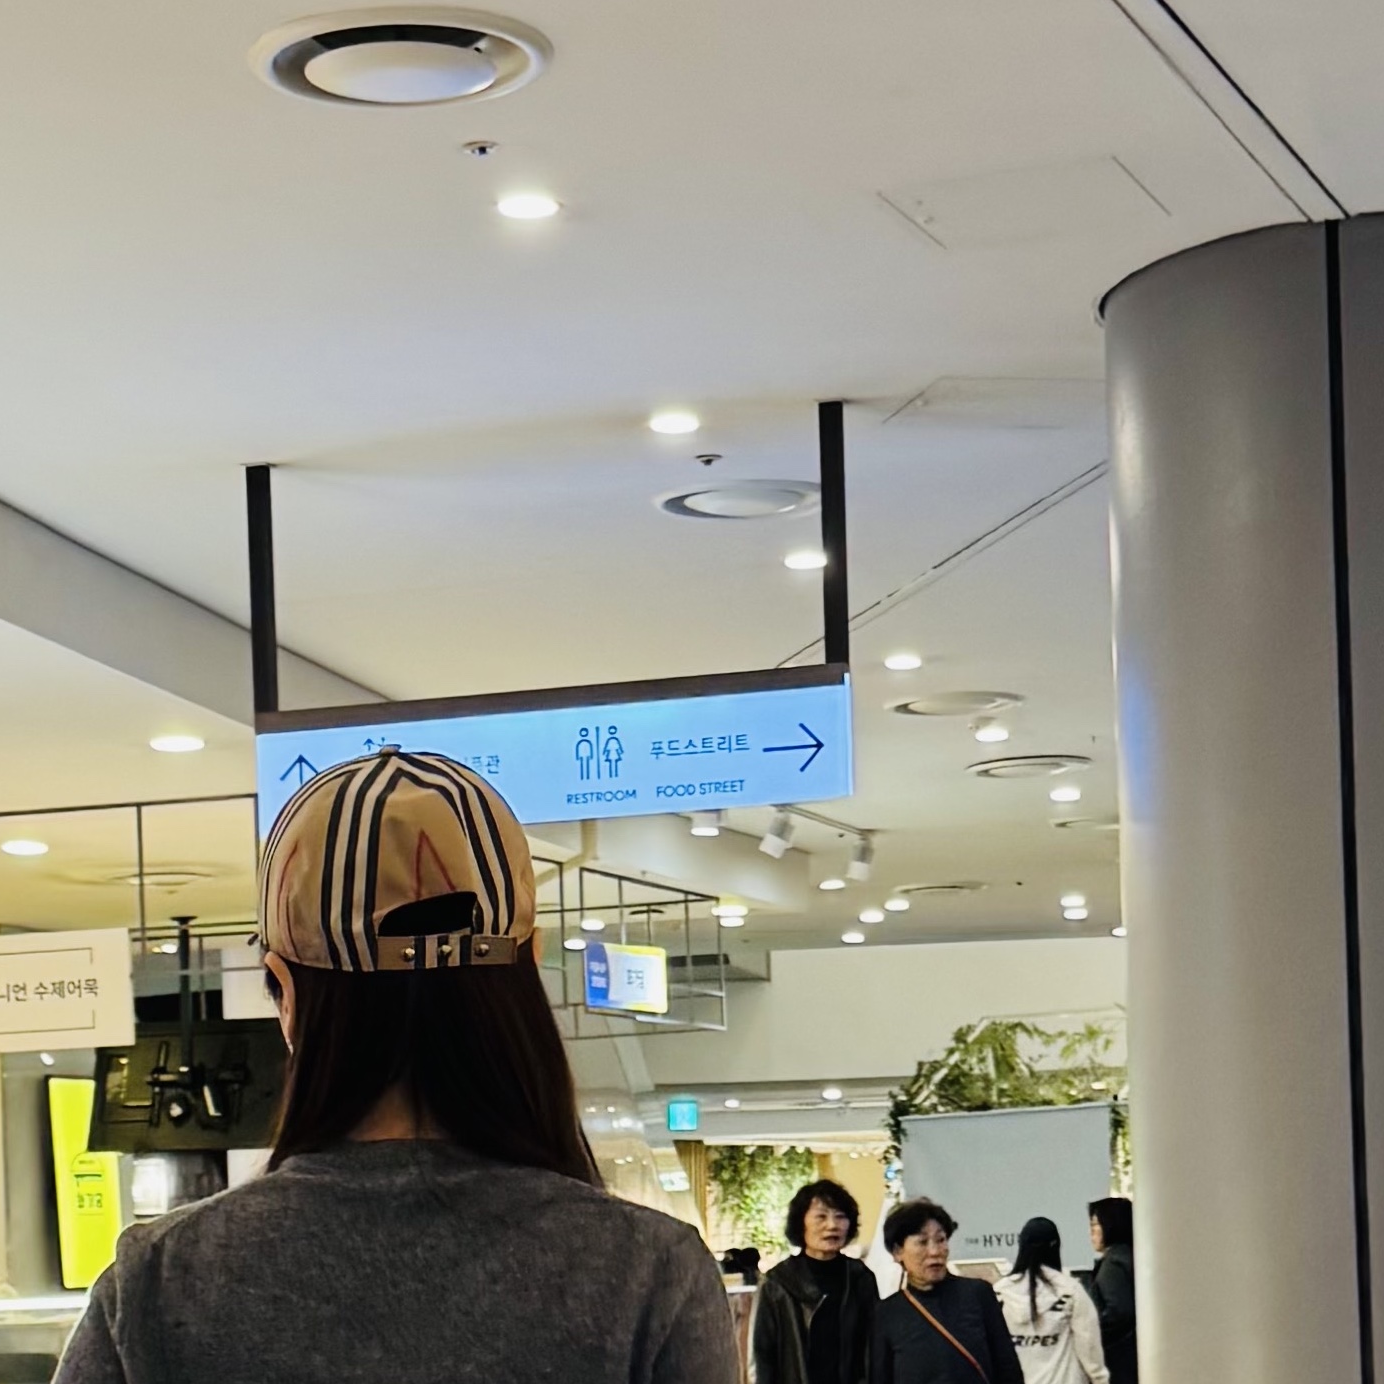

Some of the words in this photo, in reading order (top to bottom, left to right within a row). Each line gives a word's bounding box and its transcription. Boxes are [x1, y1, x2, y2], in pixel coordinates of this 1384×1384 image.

[650, 734, 750, 760] 푸드스트리트
[567, 789, 637, 805] RESTROOM
[656, 783, 696, 798] FOOD
[699, 779, 745, 795] STREET
[33, 978, 99, 1001] 수제어묵
[983, 1232, 1021, 1248] HYU
